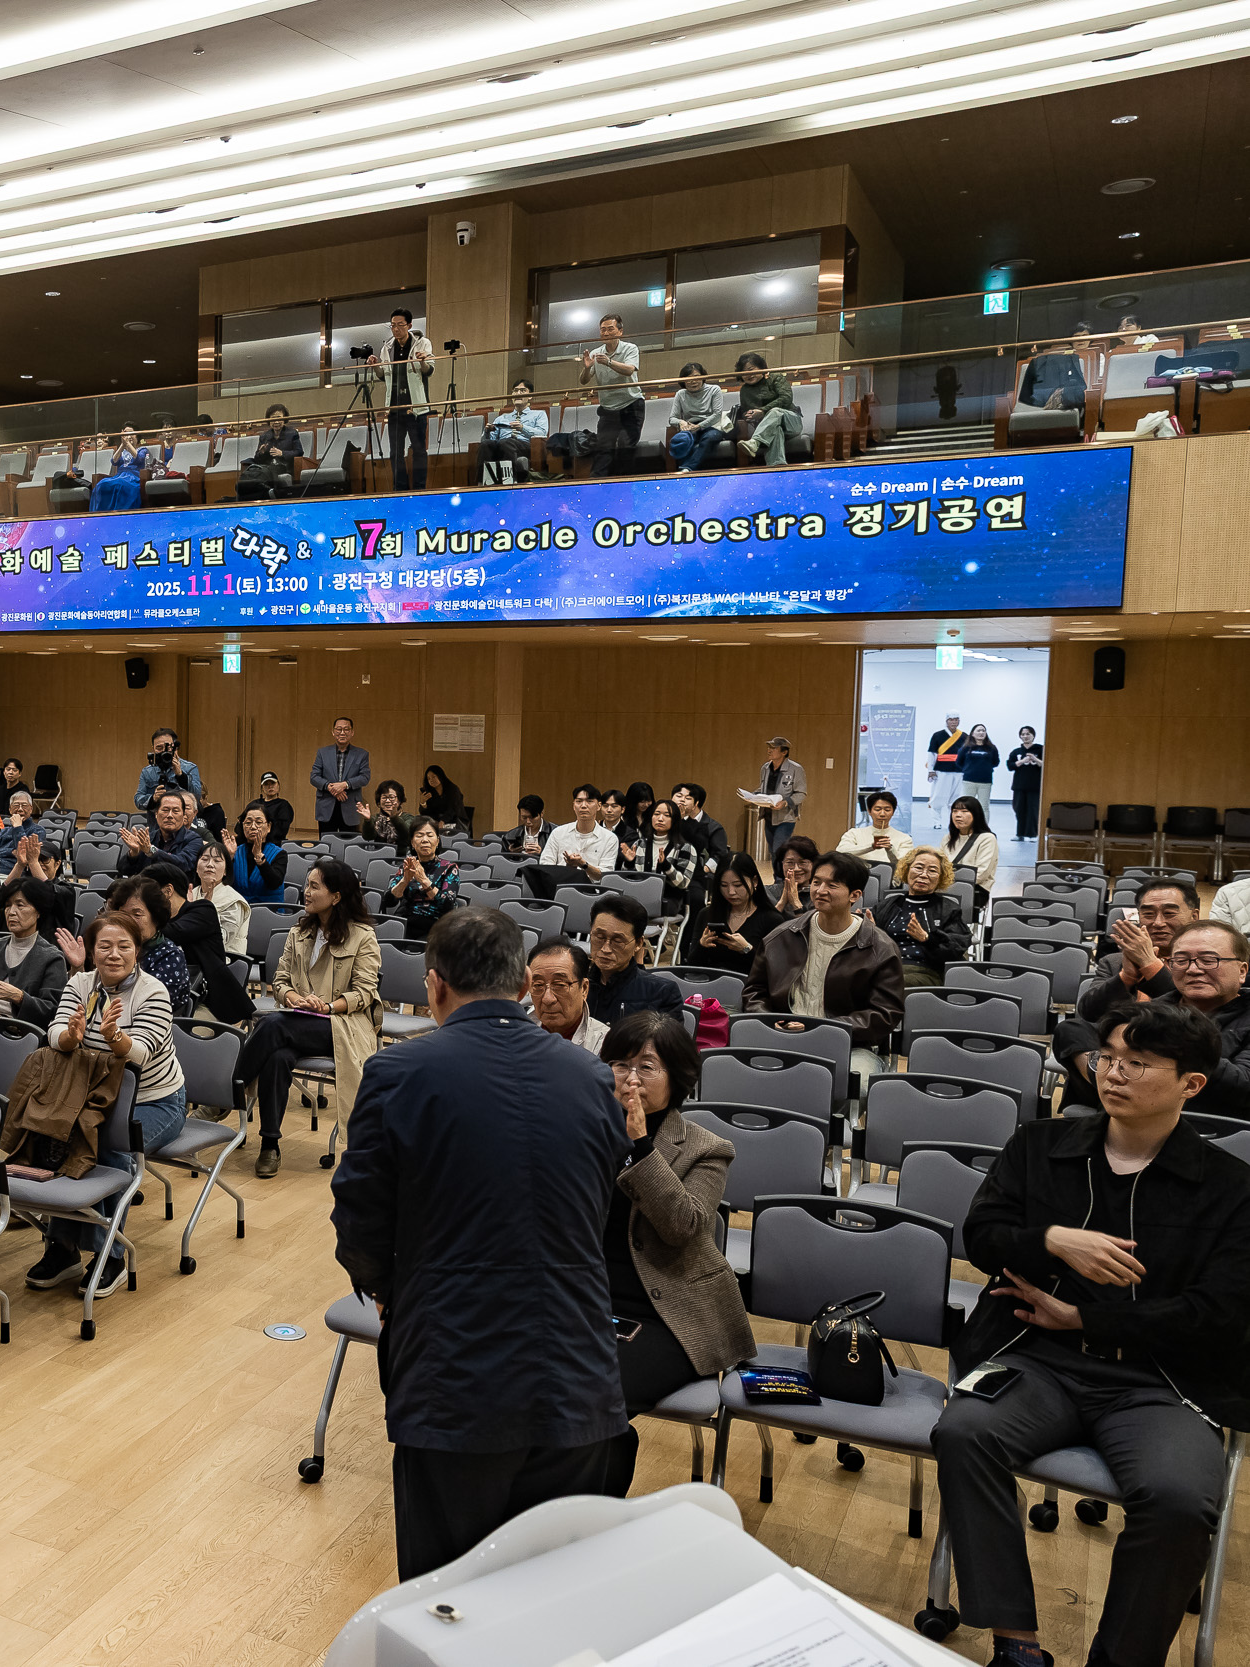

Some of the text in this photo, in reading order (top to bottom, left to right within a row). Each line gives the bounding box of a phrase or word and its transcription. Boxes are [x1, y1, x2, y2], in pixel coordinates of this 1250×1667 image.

[850, 480, 928, 496] 순수 Dream
[941, 475, 1024, 490] 손수 Dream
[102, 537, 225, 569] 페스티벌
[232, 526, 290, 576] 다락
[297, 540, 312, 560] &
[332, 520, 402, 559] 제7회
[417, 521, 577, 555] Muracle
[594, 510, 825, 546] Orchestra
[844, 493, 1026, 537] 정기공연
[266, 576, 308, 593] 13:00
[332, 571, 393, 590] 광진구청
[398, 566, 486, 588] 대강당(5층)
[561, 595, 645, 608] (주)크리에이트모어
[654, 593, 739, 606] (주)복지문화 WAC
[748, 591, 780, 603] 신난타
[271, 605, 294, 615] 광진구
[313, 603, 353, 614] 새마을운동
[355, 602, 396, 613] 광진구지회
[434, 598, 532, 611] 광진문화예술인네트워크
[534, 597, 553, 609] 다락
[1, 612, 33, 622] 광진문화원
[48, 609, 127, 620] 광진문화예술동아리연합회
[240, 607, 253, 616] 후원
